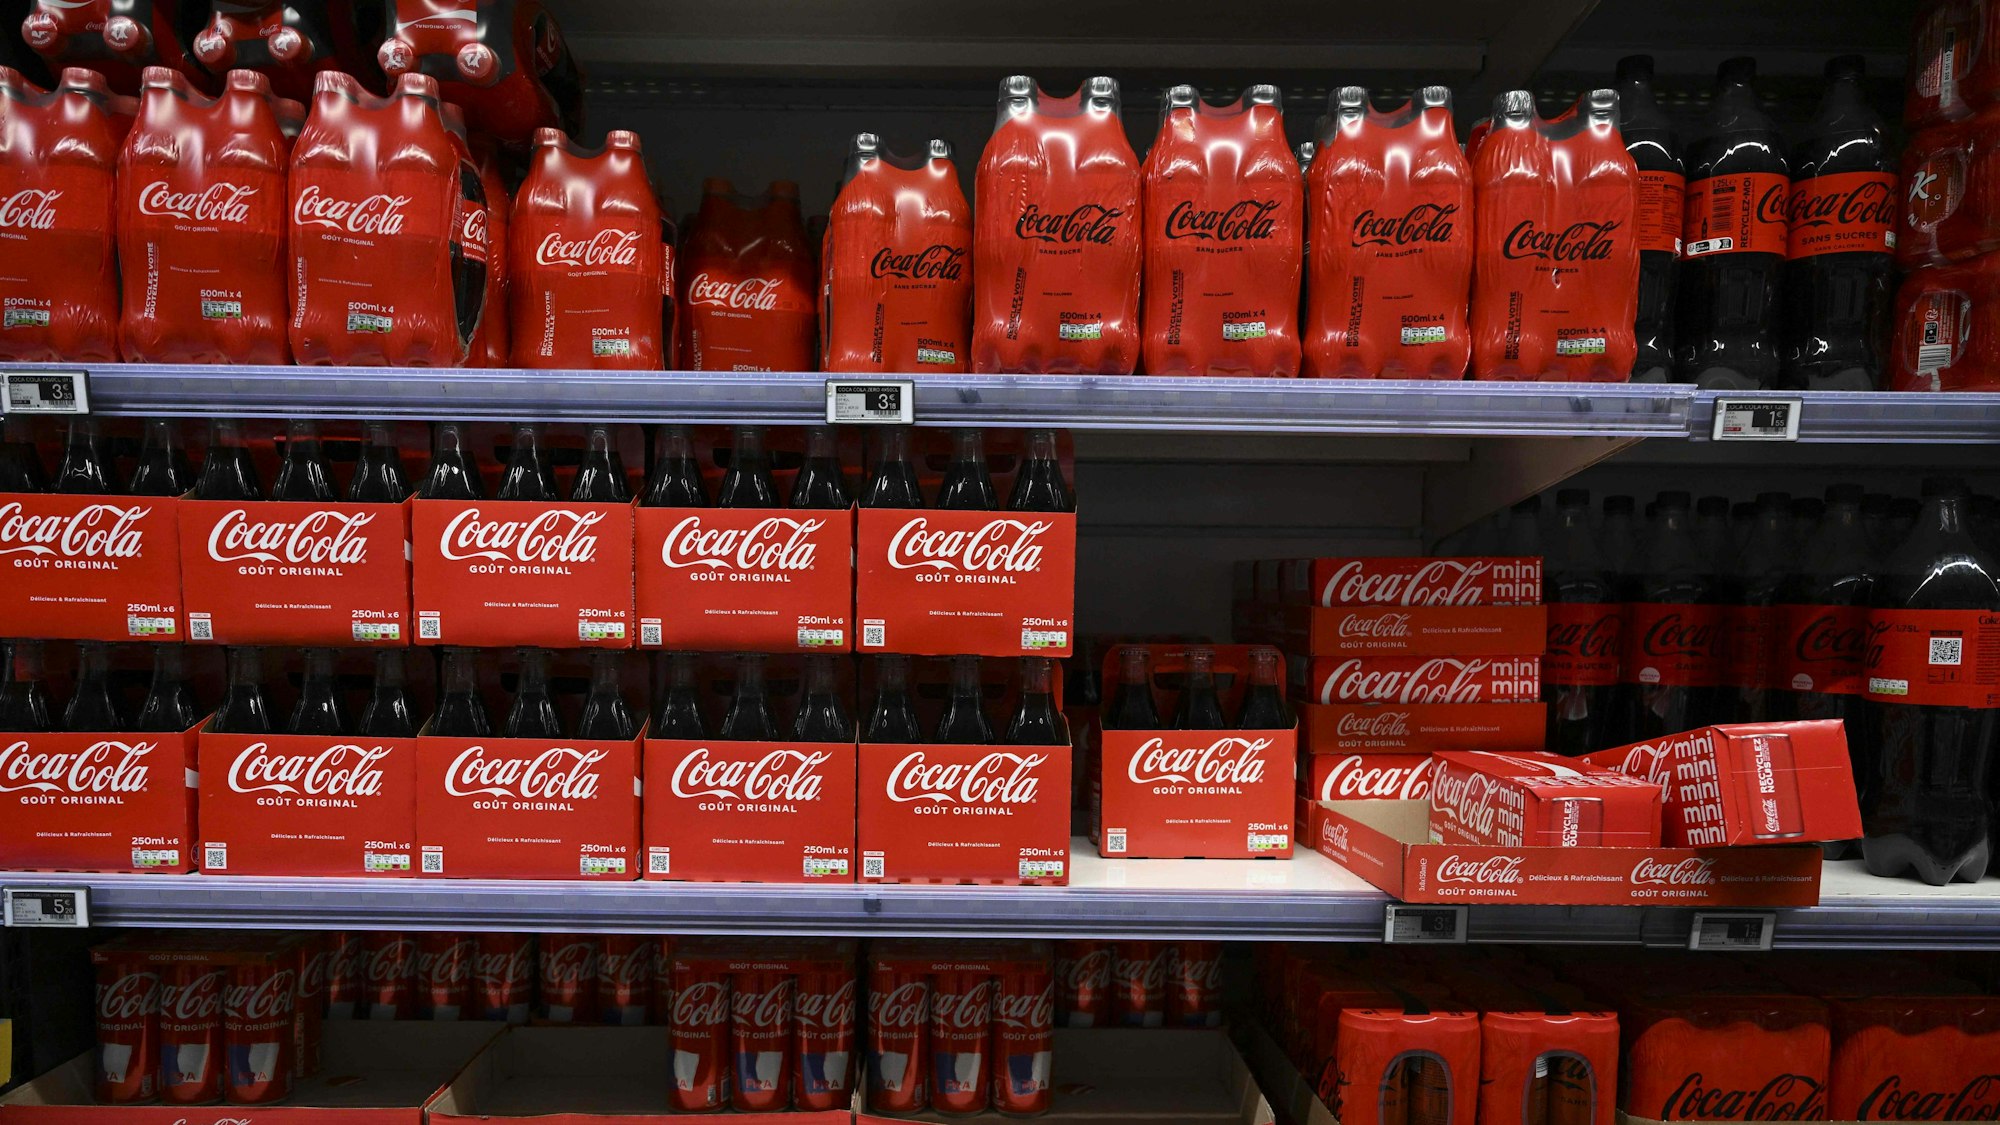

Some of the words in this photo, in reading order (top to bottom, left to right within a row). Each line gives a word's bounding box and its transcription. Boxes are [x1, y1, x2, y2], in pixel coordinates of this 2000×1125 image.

[140, 181, 259, 224] Coca-Cola
[294, 185, 412, 234] Coca-Cola
[1740, 176, 1751, 248] RECYCLEZ-MOI
[1016, 204, 1125, 245] Coca-Cola
[1166, 200, 1281, 240] Coca-Cola
[1352, 204, 1460, 247] Coca-Cola
[322, 234, 341, 242] GOÛT
[343, 236, 374, 246] ORIGINAL
[536, 228, 642, 266] Coca-Cola
[1216, 246, 1243, 254] SUCRES
[1503, 220, 1622, 262] Coca-Cola
[1802, 234, 1830, 246] SANS
[1834, 232, 1878, 241] SUCRES
[871, 244, 968, 280] Coca-Cola
[1395, 248, 1424, 257] SUCRES
[200, 290, 228, 298] 500ml
[689, 273, 784, 311] Coca-Cola
[348, 302, 380, 312] 500ml
[388, 304, 394, 313] 4
[1222, 311, 1251, 320] 500ml
[1260, 310, 1266, 318] 4
[1402, 314, 1430, 323] 500ml
[1438, 314, 1444, 322] 4
[592, 327, 616, 336] 500ml
[624, 327, 630, 336] 4
[1167, 296, 1178, 345] RECYCLEZ
[1174, 299, 1184, 345] BOUTEILLE
[541, 316, 550, 356] RECYCLEZ
[547, 315, 556, 357] BOUTEILLE
[52, 384, 63, 400] 3
[878, 394, 888, 409] 3
[1770, 411, 1775, 426] 1
[208, 509, 376, 563] Coca-Cola
[440, 508, 607, 562] Coca-Cola
[662, 516, 826, 570] Coca-Cola
[888, 518, 1054, 572] Coca-Cola
[14, 558, 49, 568] GOÛT
[54, 559, 118, 570] ORIGINAL
[239, 564, 274, 576] GOÛT
[280, 567, 343, 576] ORIGINAL
[470, 563, 504, 574] GOÛT
[510, 566, 571, 575] ORIGINAL
[1493, 560, 1541, 579] mini
[690, 571, 724, 582] GOÛT
[730, 573, 791, 583] ORIGINAL
[916, 572, 950, 583] GOÛT
[955, 574, 1016, 584] ORIGINAL
[1322, 561, 1492, 606] Coca-Cola
[1493, 579, 1541, 597] mini
[352, 610, 385, 618] 250ml
[798, 616, 830, 624] 250ml
[1338, 613, 1412, 638] Coca-Cola
[1492, 658, 1539, 676] mini
[1321, 658, 1492, 704] Coca-Cola
[1492, 676, 1539, 694] mini
[1337, 712, 1411, 736] Coca-Cola
[1338, 739, 1361, 748] GOÛT
[1674, 730, 1713, 759] mini
[228, 742, 393, 796] Coca-Cola
[445, 746, 610, 799] Coca-Cola
[1128, 738, 1273, 784] Coca-Cola
[1677, 753, 1716, 780] mini
[1753, 738, 1768, 793] RECYCLEZ
[671, 748, 832, 801] Coca-Cola
[886, 752, 1048, 804] Coca-Cola
[1764, 762, 1775, 793] NOUS
[20, 794, 55, 805] GOÛT
[61, 796, 124, 805] ORIGINAL
[1153, 785, 1183, 795] GOÛT
[1188, 787, 1242, 795] ORIGINAL
[1432, 760, 1500, 836] Coca-Cola
[1499, 786, 1525, 810] mini
[1680, 776, 1719, 802] mini
[257, 796, 292, 806] GOÛT
[296, 798, 358, 808] ORIGINAL
[473, 800, 507, 810] GOÛT
[513, 802, 574, 811] ORIGINAL
[699, 801, 732, 812] GOÛT
[737, 803, 797, 813] ORIGINAL
[914, 804, 947, 815] GOÛT
[953, 807, 1013, 815] ORIGINAL
[1684, 798, 1722, 823] mini
[1248, 822, 1277, 830] 250ml
[1498, 807, 1524, 833] mini
[132, 837, 165, 845] 250ml
[1687, 820, 1726, 845] mini
[1019, 848, 1051, 856] 250ml
[1436, 854, 1526, 884] Coca-Cola
[1529, 873, 1562, 882] Délicieux
[1570, 874, 1623, 883] Rafraîchissant
[1630, 857, 1718, 885] Coca-Cola
[1438, 887, 1466, 896] GOÛT
[1631, 888, 1659, 897] GOÛT
[54, 899, 64, 914] 5
